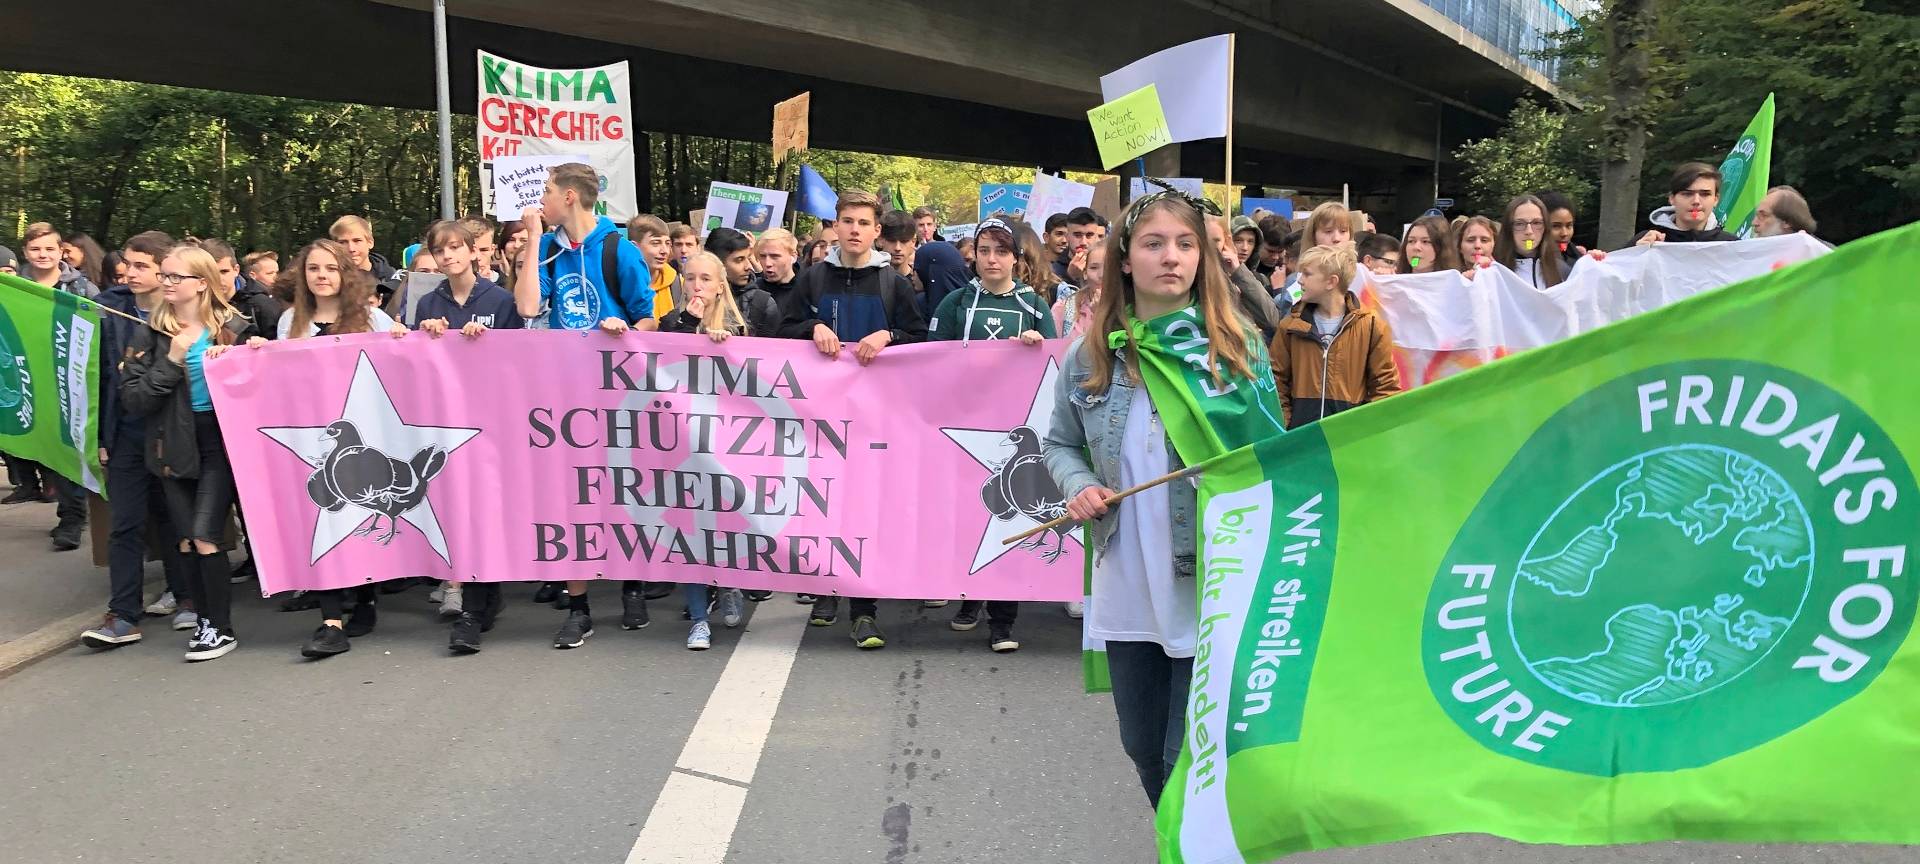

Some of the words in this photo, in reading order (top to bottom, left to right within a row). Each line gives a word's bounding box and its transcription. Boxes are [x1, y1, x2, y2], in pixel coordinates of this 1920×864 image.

[482, 55, 617, 104] KLIMA
[1093, 108, 1112, 121] We
[1104, 122, 1141, 143] Action
[1109, 107, 1135, 127] want
[1126, 118, 1166, 152] NOW!
[499, 174, 514, 185] Ihr
[518, 189, 540, 199] Erde
[712, 188, 736, 199] There
[739, 192, 746, 201] Is
[749, 194, 760, 203] No
[984, 188, 1005, 203] There
[1013, 190, 1020, 198] is
[987, 317, 1001, 326] RH
[598, 350, 808, 400] KLIMA
[529, 400, 852, 461] SCHÜTZEN
[574, 465, 835, 518] FRIEDEN
[1211, 503, 1259, 546] bis
[1280, 492, 1323, 567] Wir
[1637, 374, 1898, 525] FRIDAYS
[1791, 544, 1907, 684] FOR
[533, 522, 868, 578] BEWAHREN
[1202, 556, 1245, 601] Ihr
[1232, 577, 1307, 733] streiken,
[1437, 563, 1573, 753] FUTURE
[1188, 612, 1231, 796] handelt!
